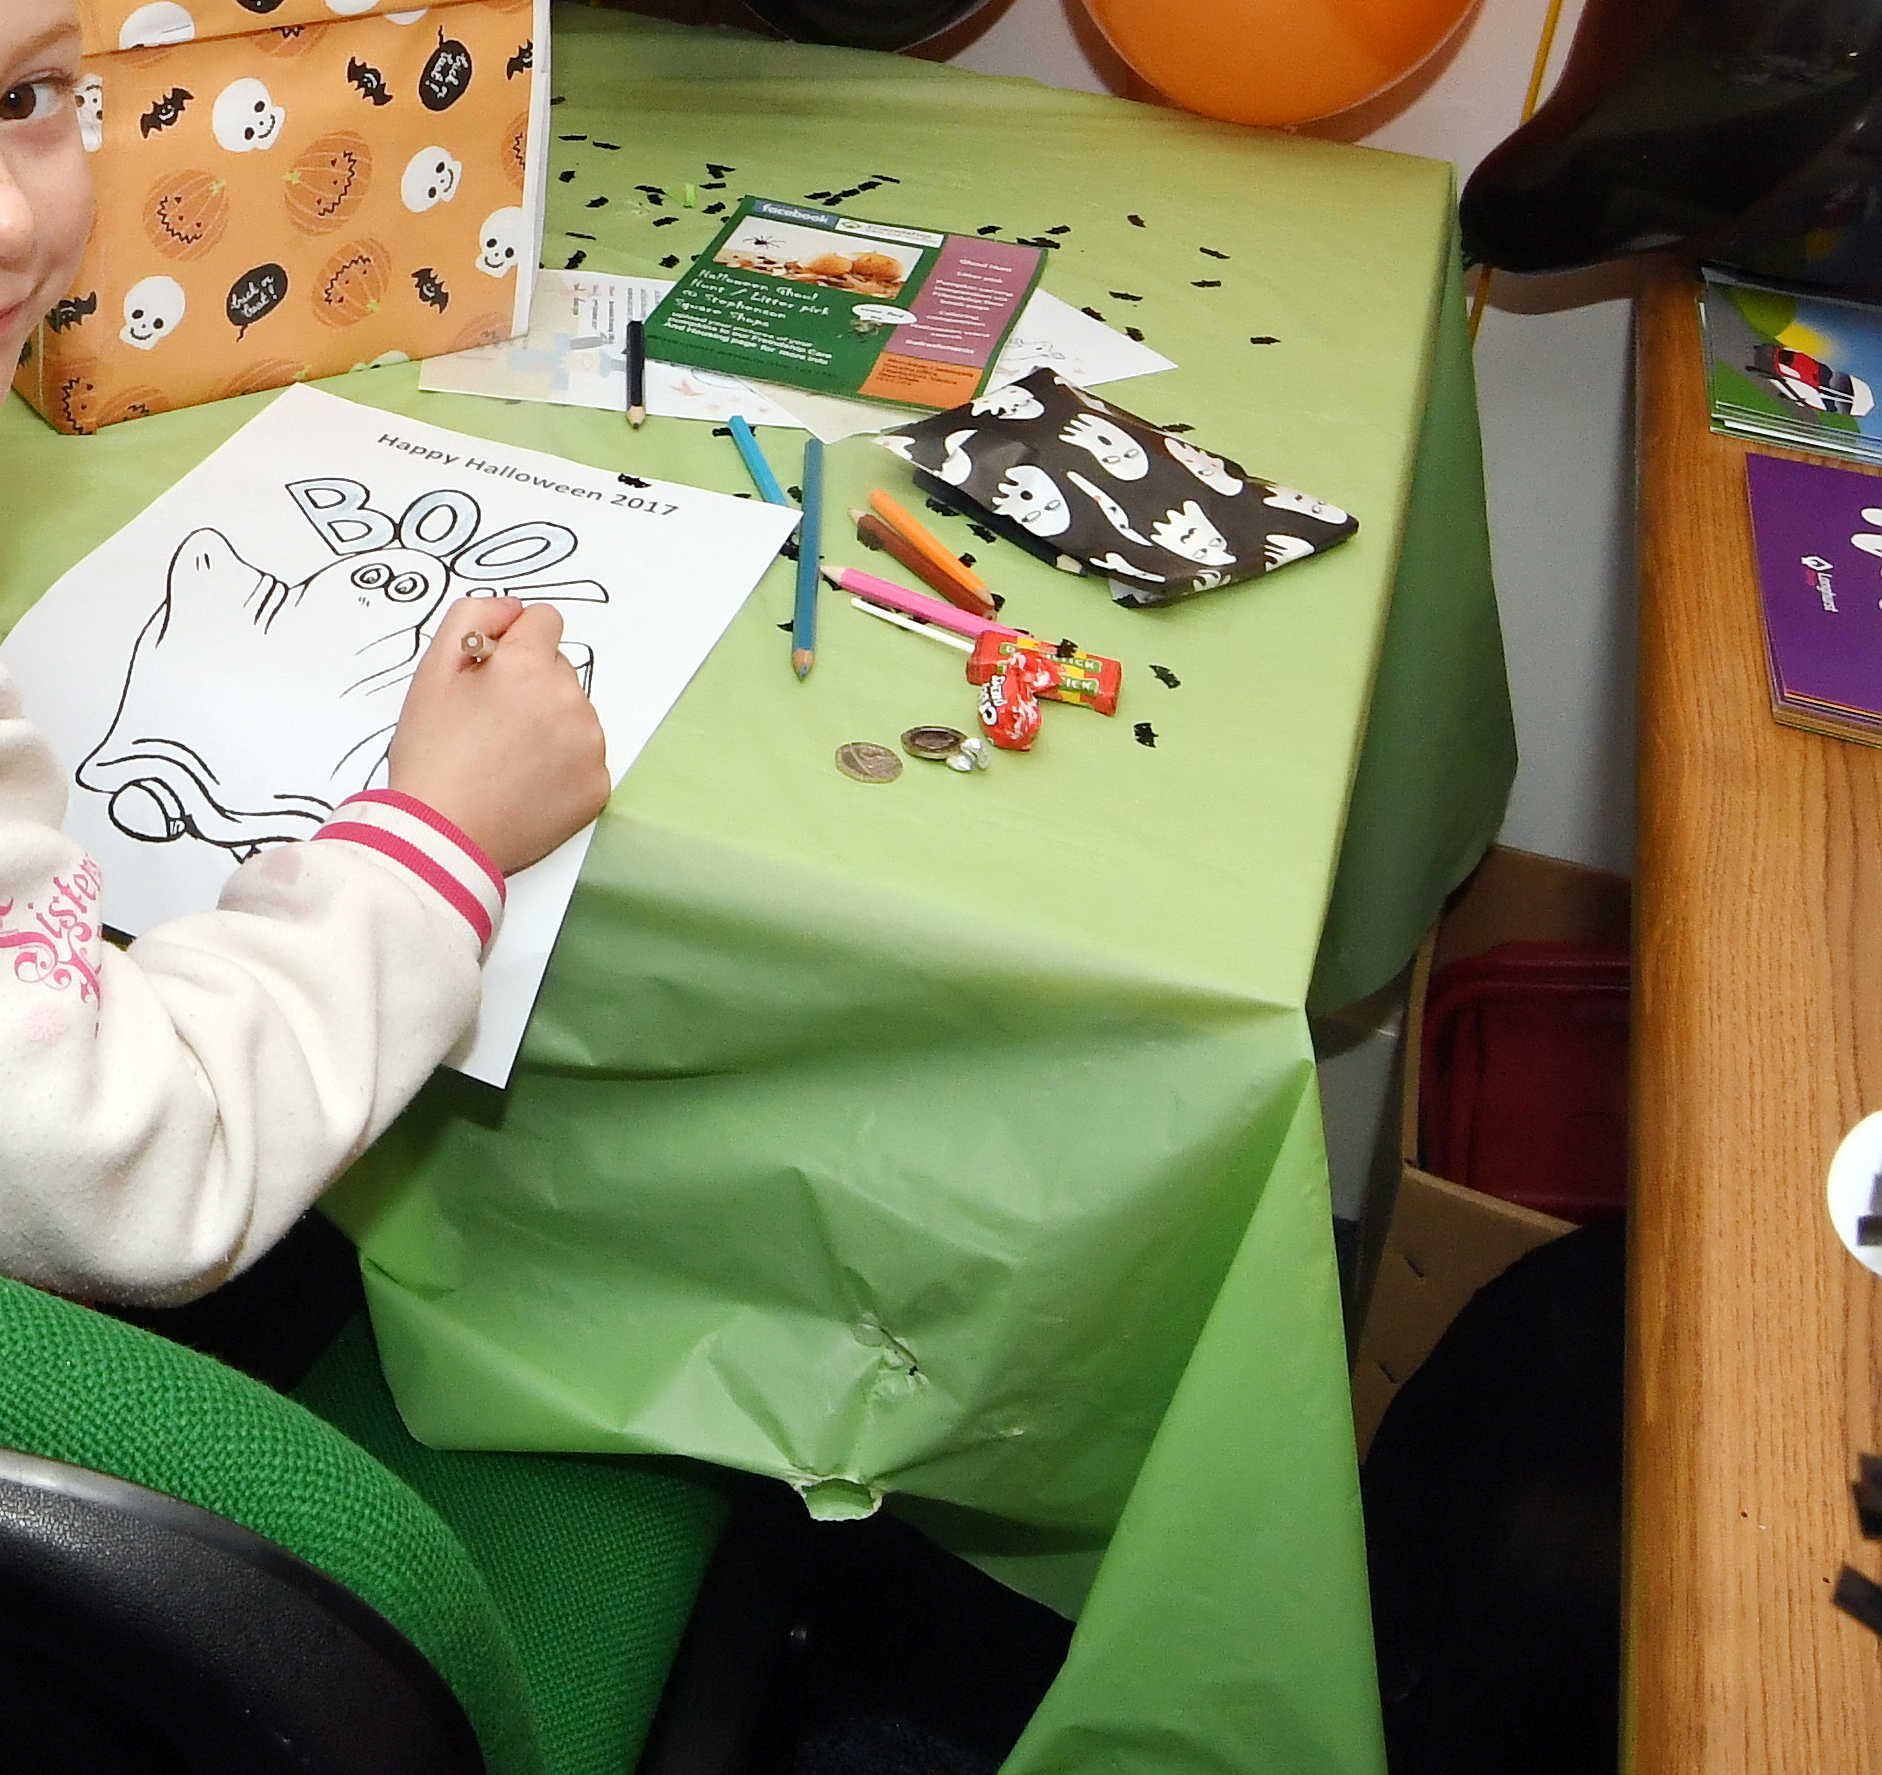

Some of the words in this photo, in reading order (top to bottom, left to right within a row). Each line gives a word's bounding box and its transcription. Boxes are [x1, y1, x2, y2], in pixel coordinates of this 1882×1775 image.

[762, 203, 829, 224] facebook
[697, 269, 769, 291] Halloween
[675, 298, 722, 315] Square
[729, 311, 770, 328] Shops
[704, 293, 787, 319] Stephenson
[750, 291, 794, 309] Litter
[376, 432, 462, 468] Happy
[464, 455, 603, 503] Halloween
[608, 491, 679, 518] 2017
[285, 477, 578, 581] BOO
